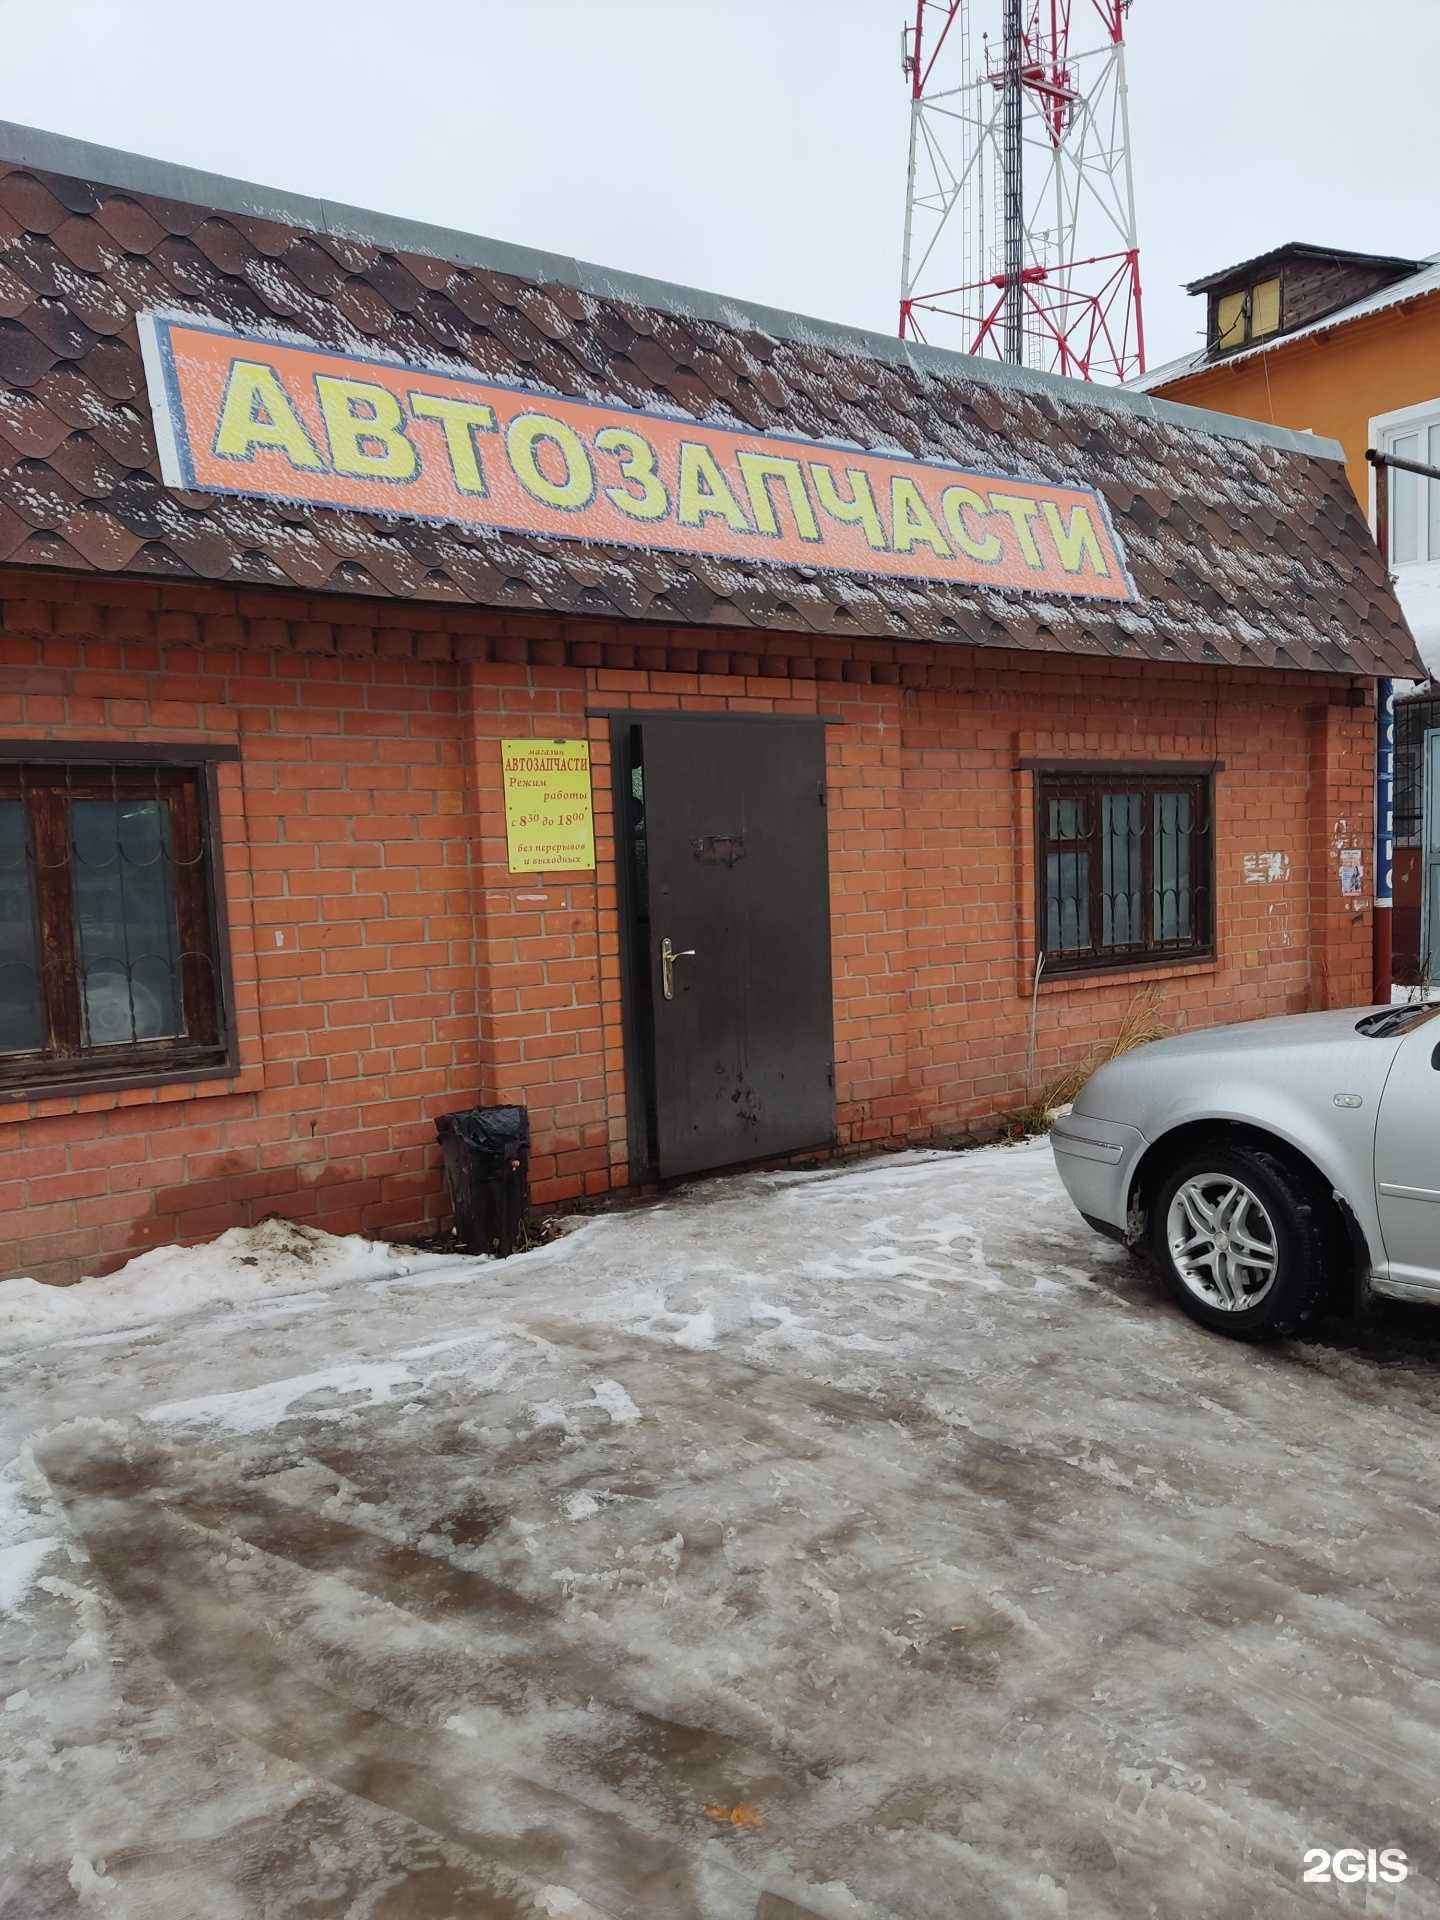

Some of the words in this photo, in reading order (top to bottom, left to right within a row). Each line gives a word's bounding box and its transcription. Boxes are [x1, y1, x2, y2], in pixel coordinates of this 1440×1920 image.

[213, 358, 1110, 577] АВТОЗАПЧАСТИ
[505, 758, 588, 771] АВТОЗАПЧАСТИ
[509, 777, 547, 788] Режим
[543, 790, 587, 803] работы
[542, 816, 554, 826] до
[517, 843, 533, 853] без
[535, 843, 586, 854] перерывов
[532, 856, 582, 865] выходных
